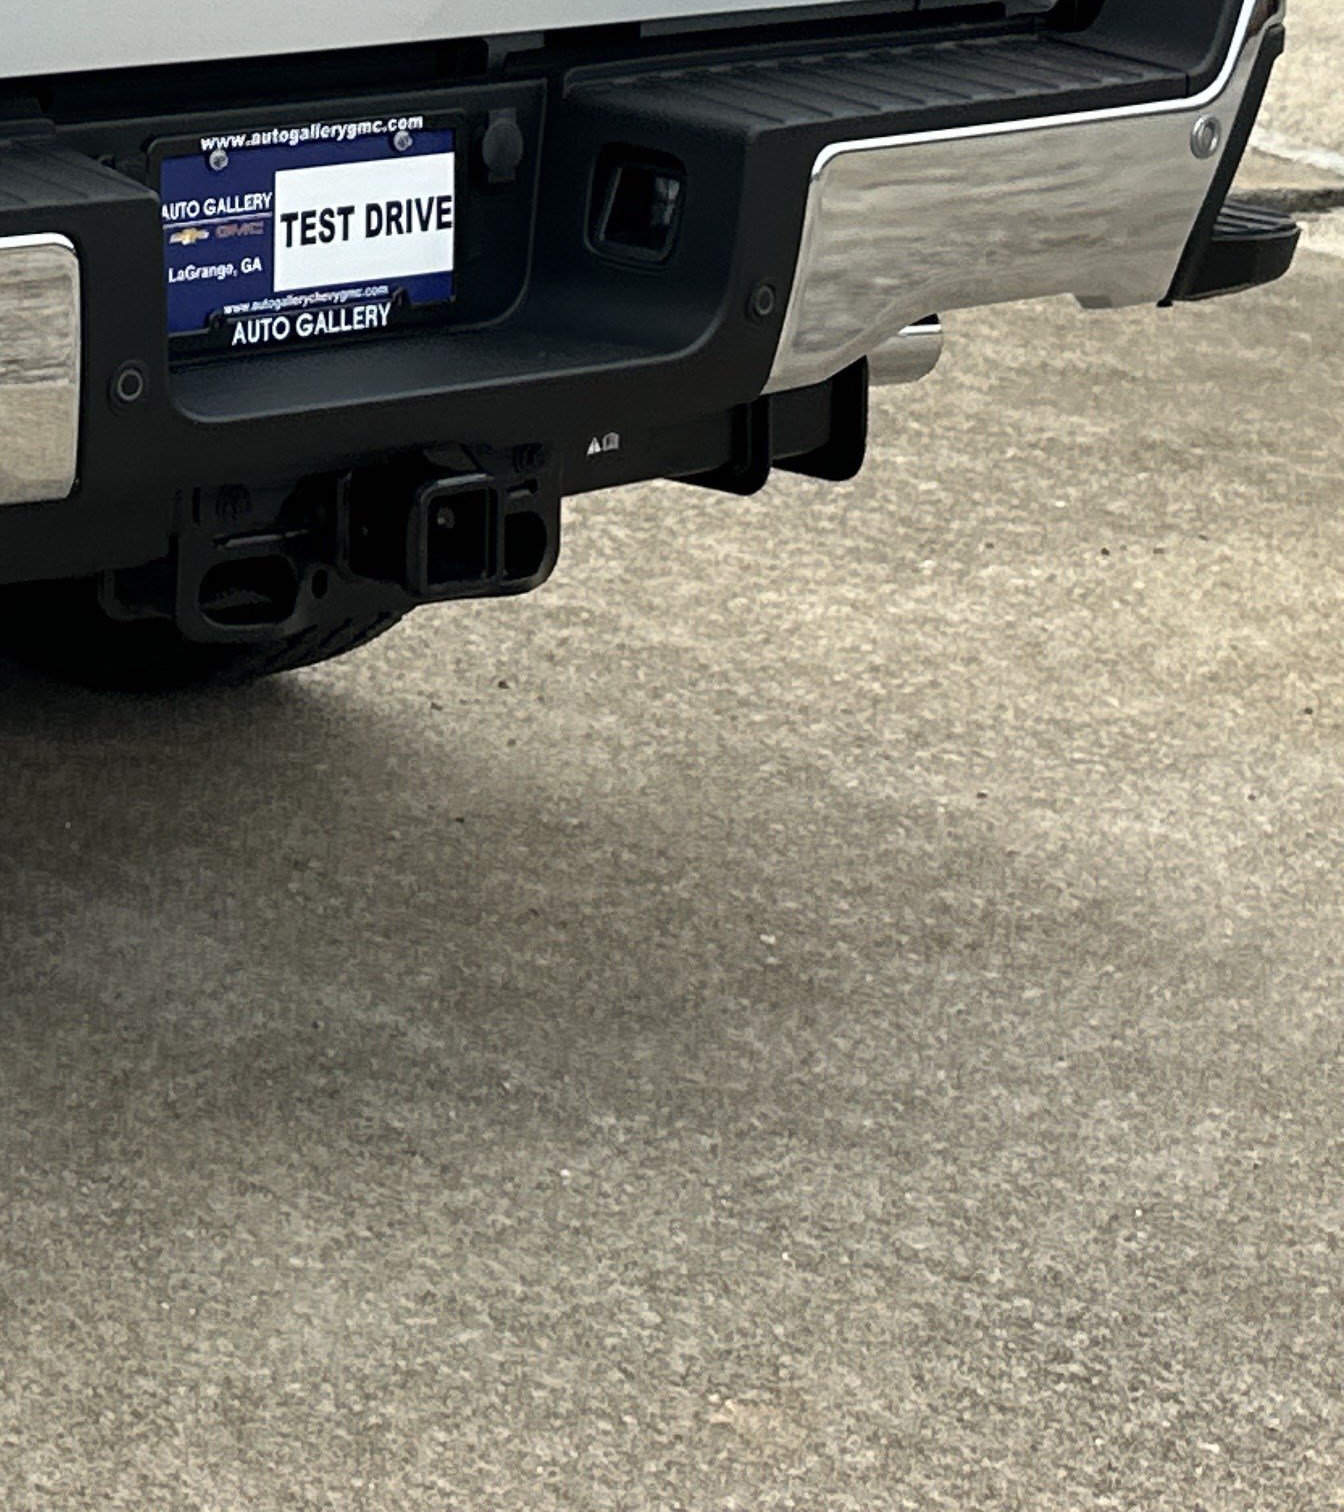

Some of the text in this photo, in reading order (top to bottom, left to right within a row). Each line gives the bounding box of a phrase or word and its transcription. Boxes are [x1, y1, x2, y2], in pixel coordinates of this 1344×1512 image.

[200, 115, 424, 151] www.autogallerygmc.com
[162, 191, 273, 221] AUTO GALLERY
[280, 194, 453, 248] TEST DRIVE
[168, 256, 263, 284] LaGrange, GA
[231, 301, 392, 347] AUTO GALLERY
